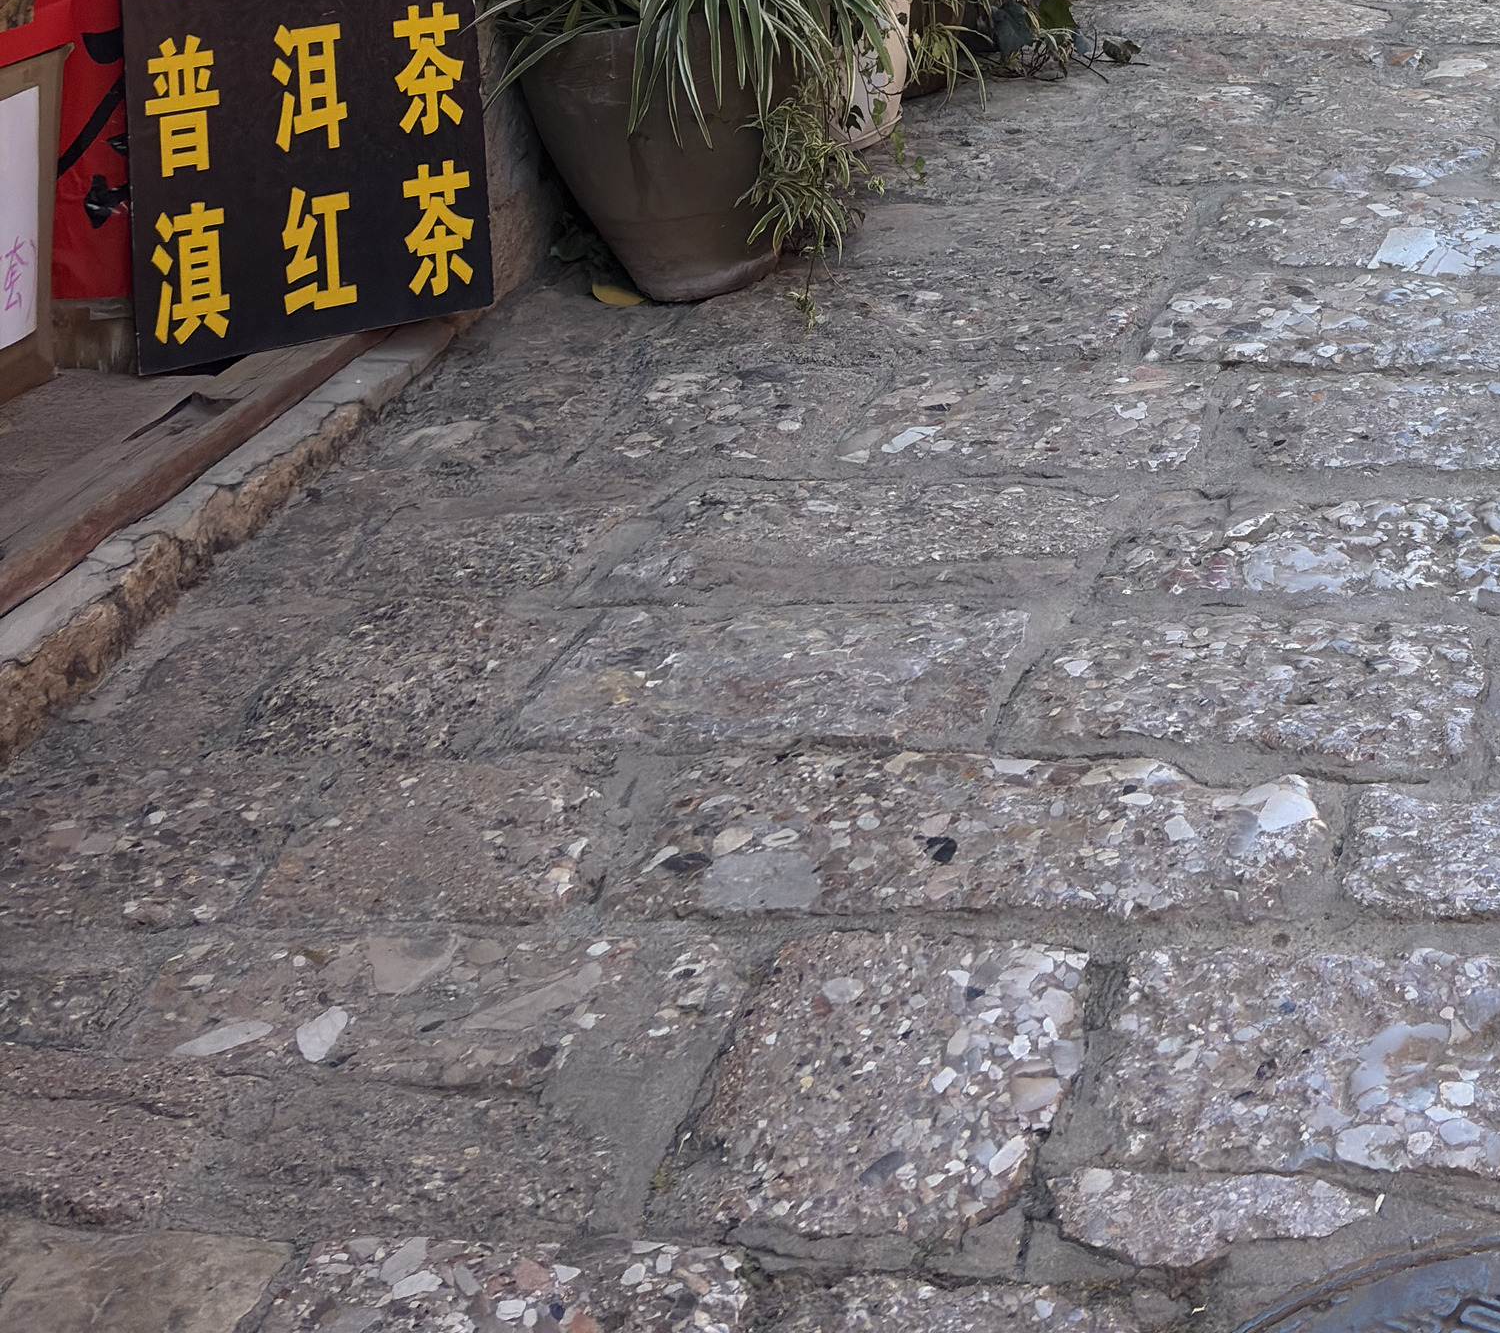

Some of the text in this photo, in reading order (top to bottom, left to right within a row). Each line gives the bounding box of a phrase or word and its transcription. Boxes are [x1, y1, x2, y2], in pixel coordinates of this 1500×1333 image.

[144, 1, 465, 179] 普洱茶
[153, 160, 475, 346] 滇红茶
